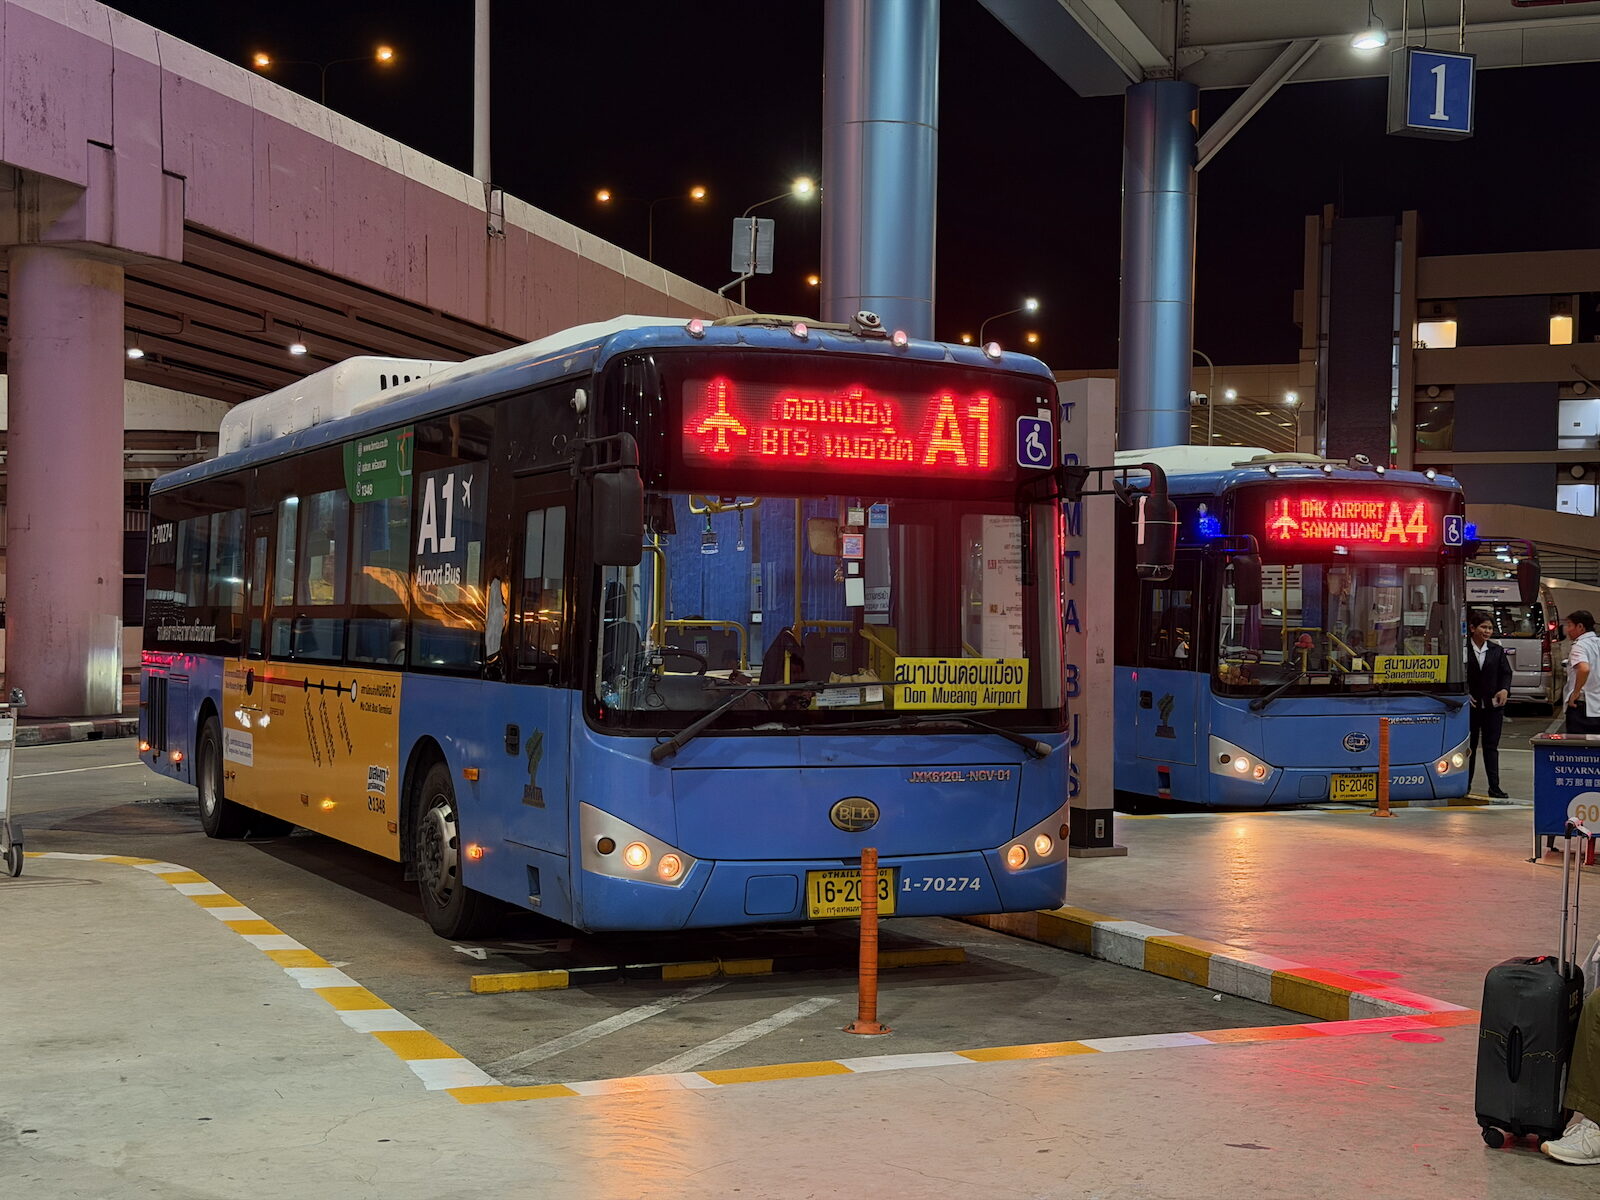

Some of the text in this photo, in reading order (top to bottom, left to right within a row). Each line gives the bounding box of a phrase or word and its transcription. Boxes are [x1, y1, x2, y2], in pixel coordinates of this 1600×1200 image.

[1429, 63, 1449, 121] 1
[783, 389, 893, 425] ดอนเมือง
[921, 392, 990, 468] A1
[761, 426, 914, 462] BTS หมอชิต
[361, 484, 374, 497] 1348
[417, 473, 456, 555] A1
[1301, 500, 1385, 519] DMK AIRPORT
[1301, 521, 1383, 539] SANAMLUANG
[1380, 500, 1428, 544] A4
[151, 522, 173, 545] 1-70274
[416, 562, 461, 592] Airport Bus
[895, 658, 1024, 685] สนามบินดอนเมือง
[1383, 657, 1440, 670] สนามหลวง
[1384, 670, 1436, 680] Sanamluang
[392, 684, 397, 698] 2
[903, 686, 926, 704] Don
[931, 686, 978, 706] Mueang
[982, 686, 1021, 706] Airport
[1555, 766, 1600, 775] SUVARNA
[1334, 778, 1374, 793] 16-2046
[372, 797, 386, 815] 1348
[838, 806, 871, 821] BLK
[816, 878, 890, 905] 16-203
[902, 877, 981, 892] 1-70274
